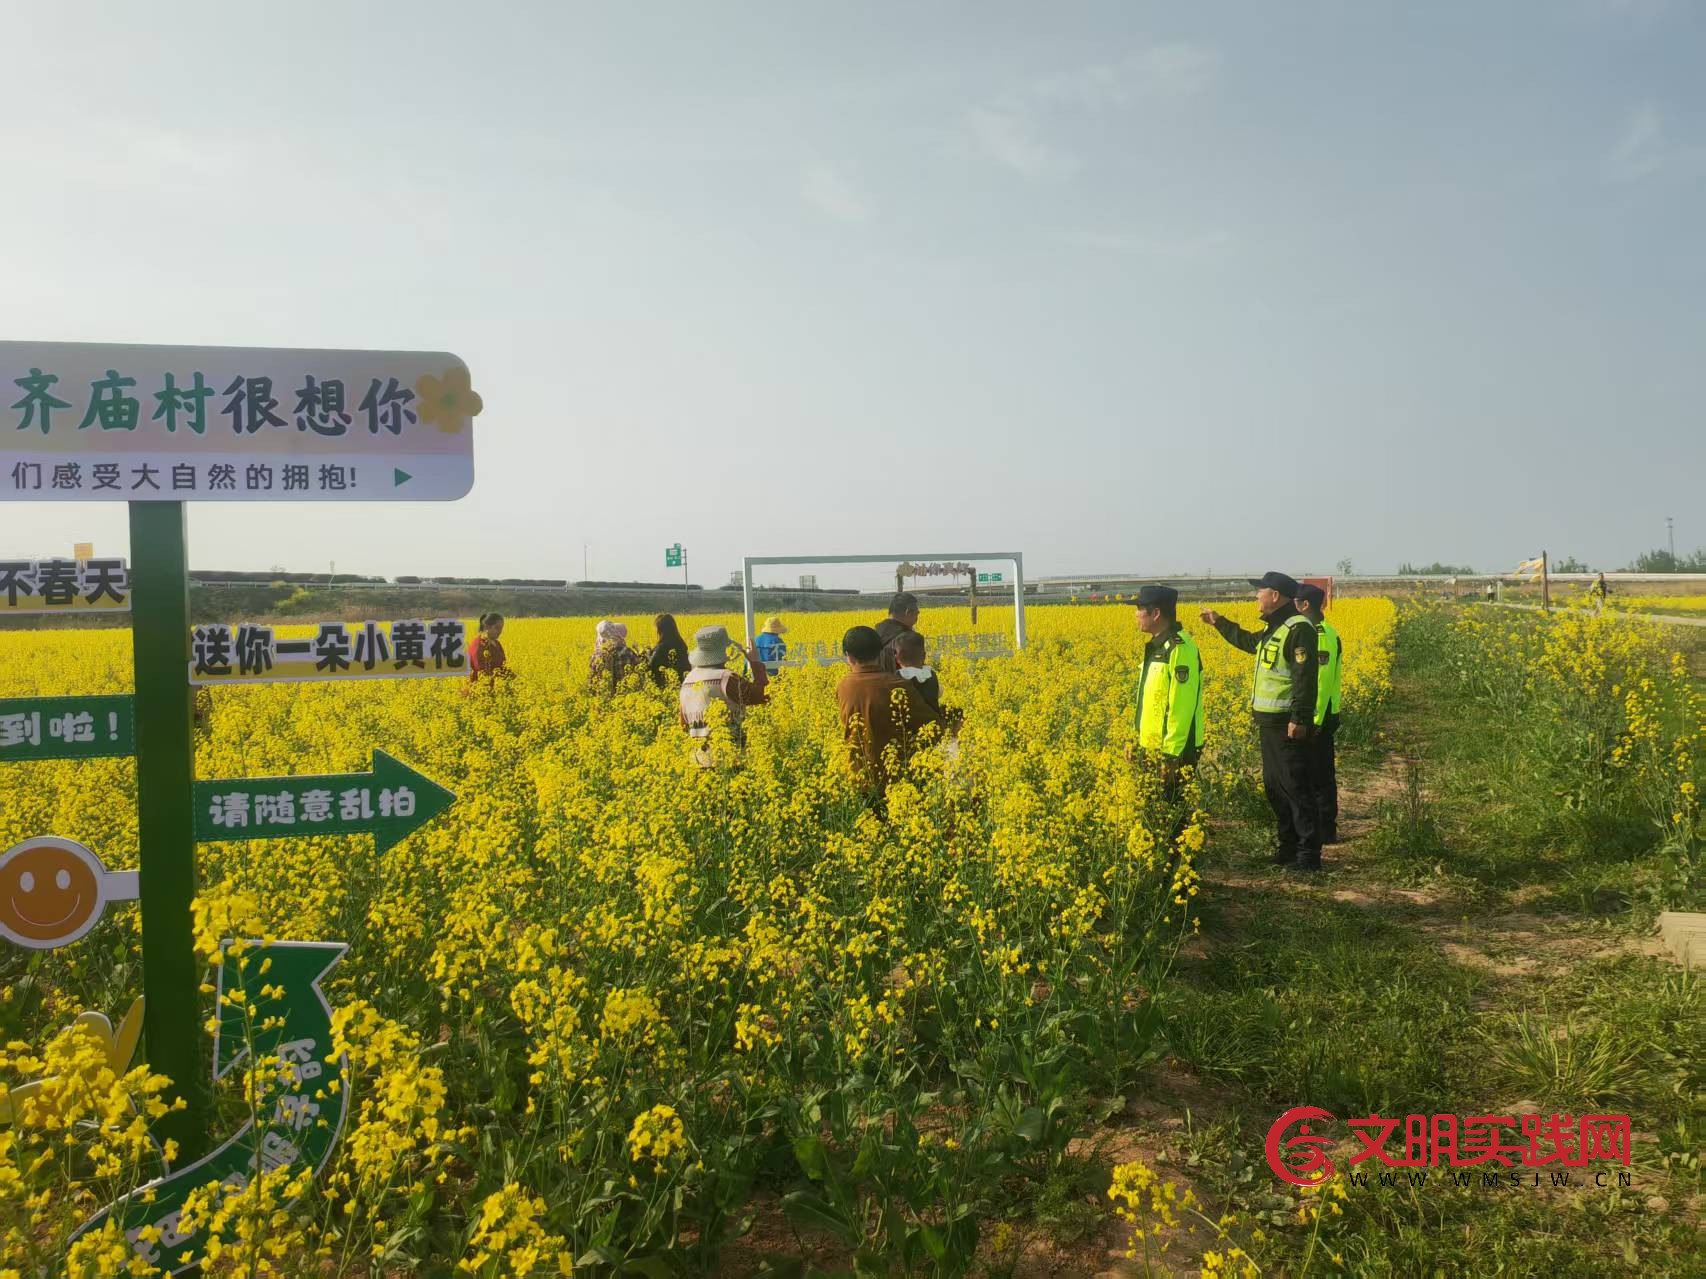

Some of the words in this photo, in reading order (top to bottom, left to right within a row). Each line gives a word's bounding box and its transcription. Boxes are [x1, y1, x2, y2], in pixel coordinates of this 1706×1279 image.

[11, 368, 415, 436] 齐庙村很想你
[11, 461, 357, 491] 们感受大自然的拥抱!
[0, 559, 125, 607] 不春天
[193, 622, 466, 677] 送你一朵小黄花
[208, 786, 417, 828] 请随意乱拍
